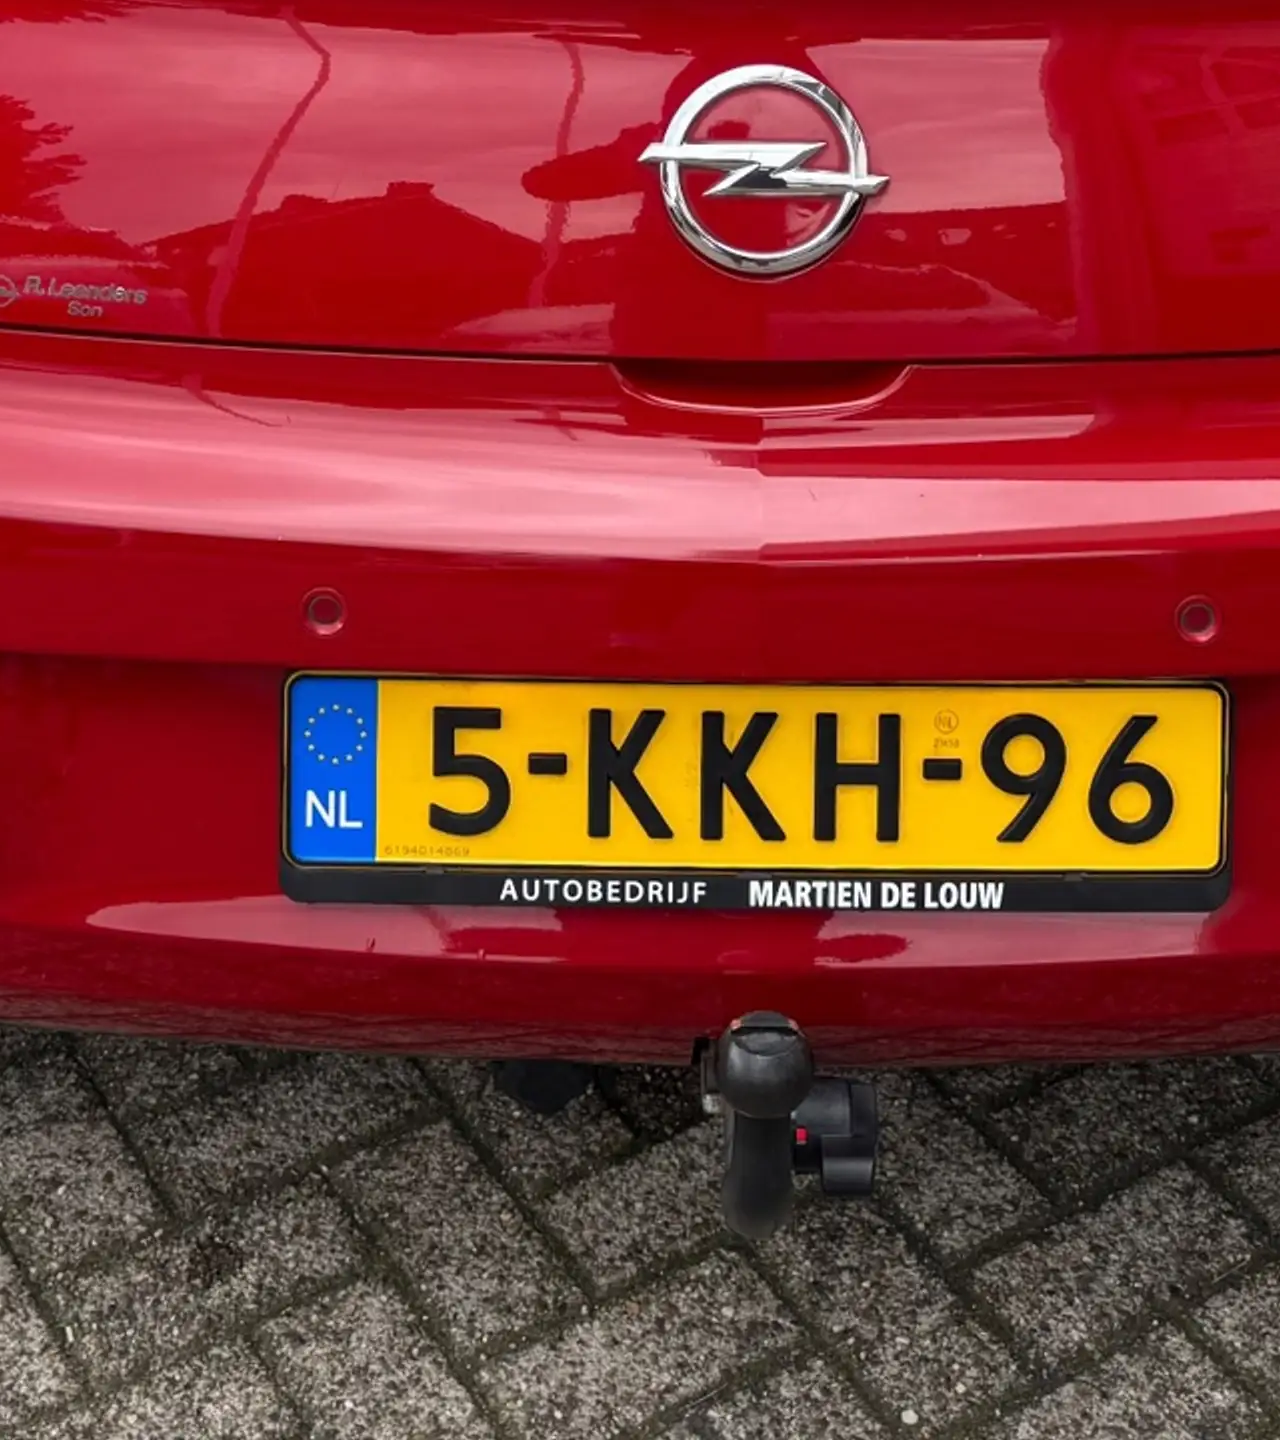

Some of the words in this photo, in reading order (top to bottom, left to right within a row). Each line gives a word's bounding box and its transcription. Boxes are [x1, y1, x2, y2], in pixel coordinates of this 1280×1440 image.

[67, 300, 104, 317] Son
[428, 705, 1175, 845] 5-KKH-96
[304, 789, 364, 829] NL
[499, 878, 708, 904] AUTOBEDRIJF
[748, 879, 872, 908] MARTIEN
[880, 881, 917, 908] DE
[923, 881, 1005, 910] LOUW
